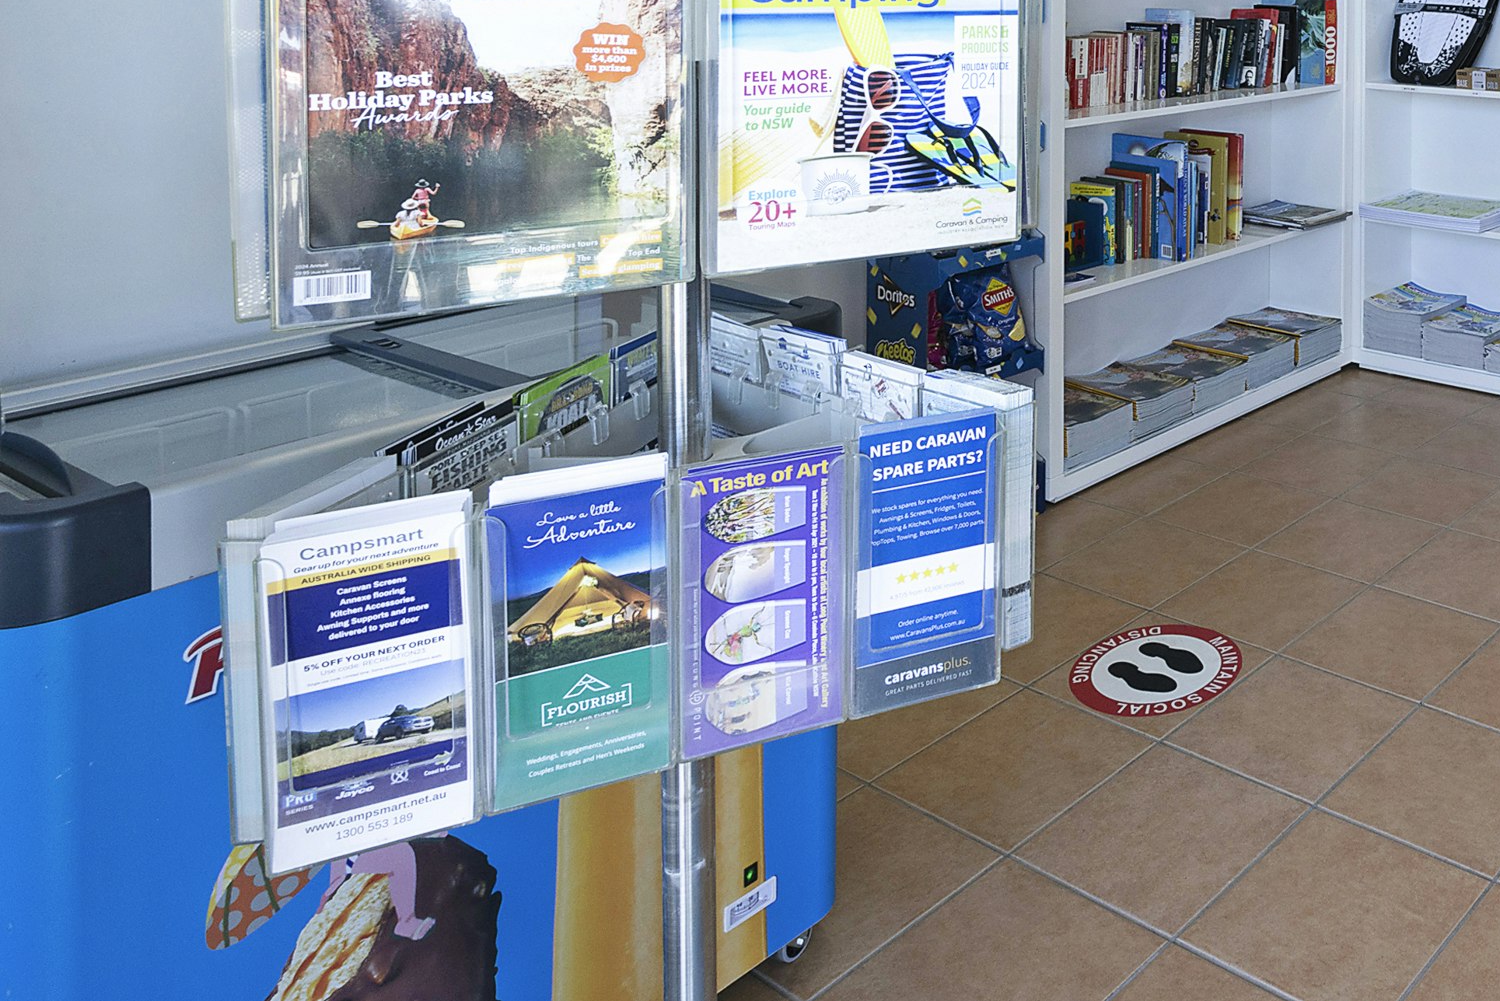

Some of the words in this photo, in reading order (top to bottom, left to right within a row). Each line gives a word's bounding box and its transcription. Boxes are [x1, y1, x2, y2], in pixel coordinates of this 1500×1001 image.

[592, 33, 629, 46] WIN
[375, 71, 432, 89] Best
[744, 70, 777, 82] FEEL
[782, 69, 832, 82] MORE.
[961, 72, 996, 90] 2024
[309, 89, 415, 112] Holiday
[420, 87, 493, 106] Parks
[744, 84, 777, 96] LIVE
[782, 82, 832, 95] MORE.
[353, 105, 459, 130] Awards
[877, 284, 915, 308] Doritos
[982, 286, 1014, 307] SMITH'S
[777, 360, 800, 375] BOAT
[801, 367, 821, 380] HIRE
[475, 415, 497, 431] Star
[870, 436, 912, 459] NEED
[916, 426, 987, 451] CARAVAN
[690, 481, 706, 497] A
[709, 472, 766, 496] Taste
[772, 465, 793, 483] of
[797, 459, 829, 478] Art
[872, 458, 924, 482] SPARE
[927, 449, 983, 472] PARTS?
[536, 512, 577, 526] Love
[590, 501, 621, 516] little
[300, 529, 424, 561] Campsmart
[301, 569, 356, 585] AUSTRALIA
[359, 563, 383, 574] WIDE
[386, 555, 431, 568] SHIPPING
[890, 620, 965, 641] www.CaravansPlus.com.au
[304, 663, 319, 672] 5%
[322, 658, 344, 668] OFF
[346, 651, 375, 662] YOUR
[378, 644, 406, 656] NEXT
[409, 635, 445, 648] ORDER
[1072, 626, 1162, 684] DISTANCING
[1203, 635, 1238, 694] MAINTAIN
[547, 690, 627, 719] FLOURISH
[1117, 693, 1203, 715] SOCIAL
[305, 791, 447, 834] www.campsmart.net.au
[336, 827, 364, 840] 1300
[368, 820, 388, 832] 553
[393, 813, 413, 824] 189
